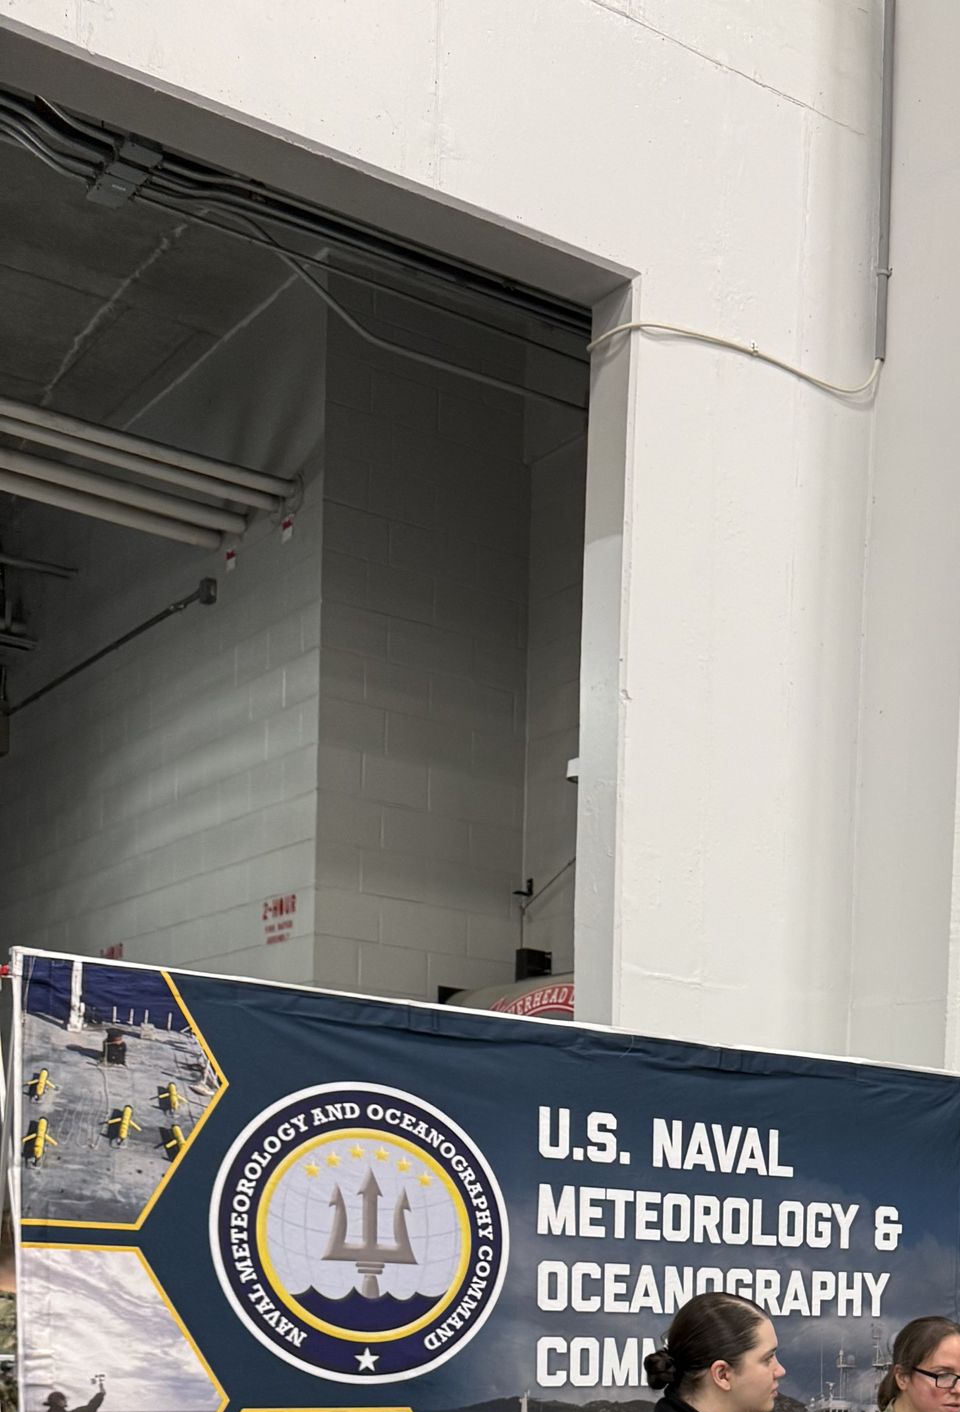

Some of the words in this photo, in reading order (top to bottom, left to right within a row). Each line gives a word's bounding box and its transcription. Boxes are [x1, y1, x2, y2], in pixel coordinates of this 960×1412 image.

[507, 987, 569, 1015] ERHEAD
[312, 1102, 361, 1126] AND
[538, 1106, 631, 1165] U.S.
[652, 1118, 794, 1178] NAVAL
[230, 1116, 308, 1284] METEOROLOGY
[366, 1103, 494, 1241] OCEANOGRAPHY
[536, 1183, 860, 1250] METEOROLOGY
[873, 1205, 903, 1251] &
[248, 1286, 308, 1348] NAVAL
[422, 1245, 494, 1352] COMMAND
[536, 1260, 891, 1318] OCEANOGRAPHY
